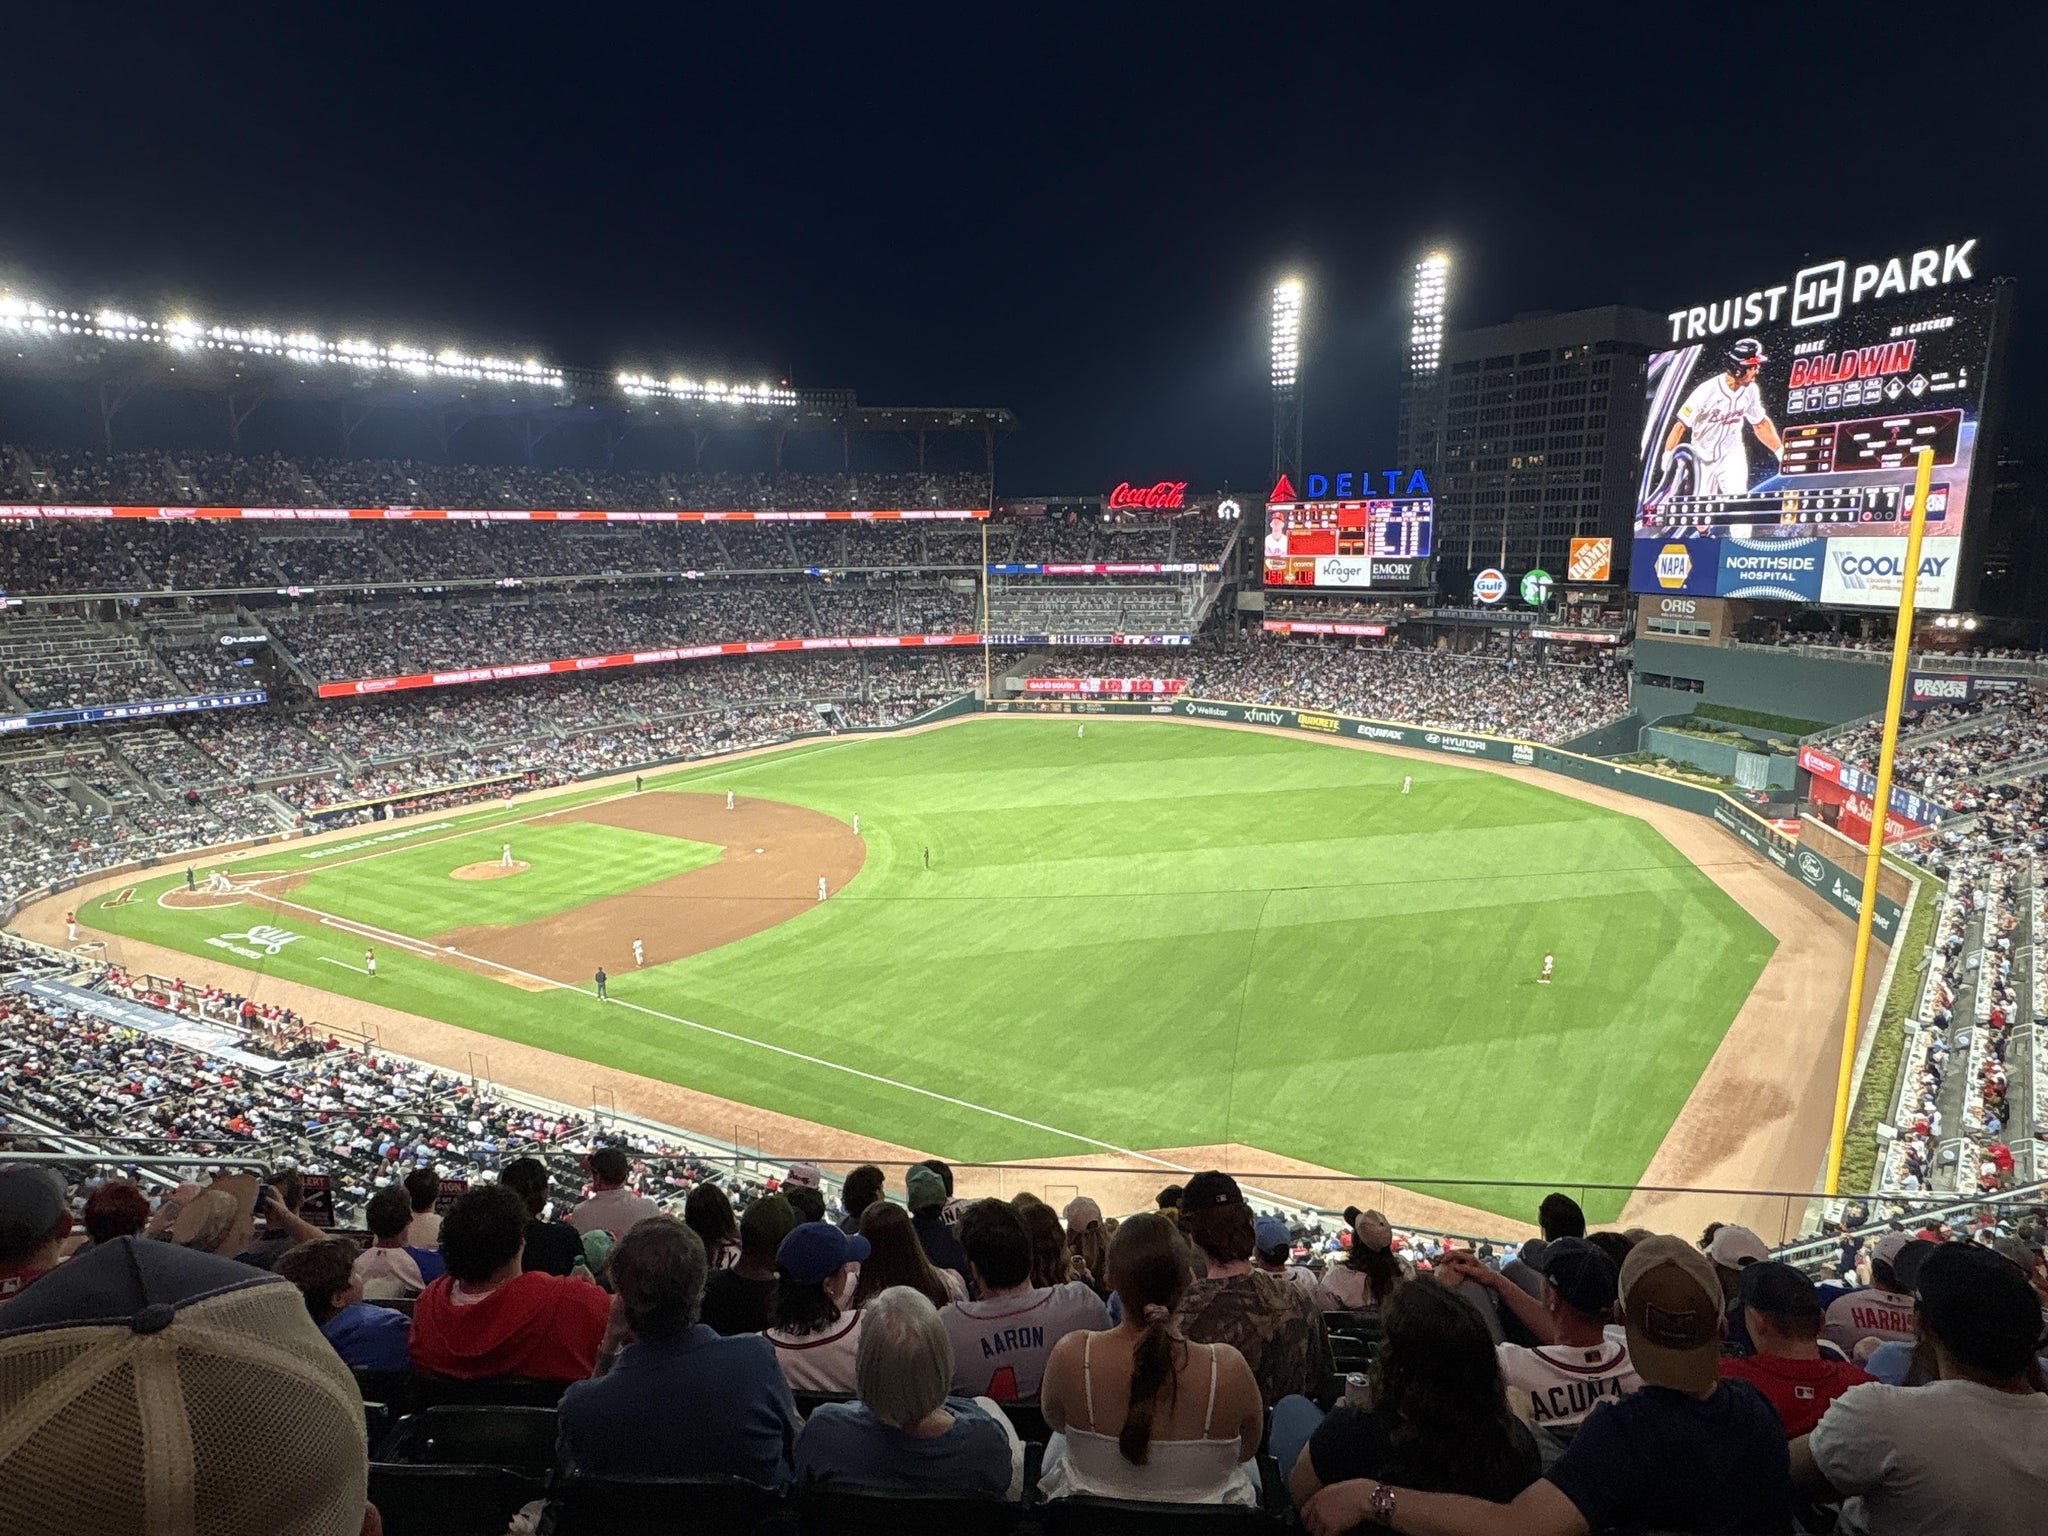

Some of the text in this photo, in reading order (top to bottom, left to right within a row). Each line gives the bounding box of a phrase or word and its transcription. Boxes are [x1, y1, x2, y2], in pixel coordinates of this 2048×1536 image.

[1668, 239, 1976, 342] TRUIST PARK
[1794, 340, 1826, 355] DRAKE
[1788, 339, 1917, 389] BALDWIN
[1308, 469, 1430, 498] DELTA
[1670, 505, 1677, 513] 0
[1681, 504, 1688, 513] 0
[1693, 504, 1700, 512] 2
[1705, 503, 1712, 512] 0
[1801, 499, 1809, 509] 7
[1816, 499, 1824, 508] 0
[1832, 498, 1840, 508] 7
[1849, 497, 1855, 507] 1
[1868, 493, 1876, 508] 1
[1886, 492, 1895, 508] 1
[1669, 516, 1676, 525] 0
[1680, 516, 1687, 525] 0
[1692, 516, 1698, 525] 2
[1704, 516, 1711, 525] 0
[1815, 512, 1823, 522] 0
[1830, 512, 1838, 522] 4
[1848, 512, 1854, 521] 1
[1570, 539, 1609, 579] HOME
[1660, 556, 1686, 577] NAPA
[1726, 556, 1815, 571] NORTHSIDE
[1841, 553, 1950, 577] COOLAY
[1323, 559, 1362, 583] Kroger
[1372, 563, 1413, 575] EMORY
[1740, 571, 1796, 582] HOSPITAL
[1477, 581, 1503, 591] Gulf
[1660, 599, 1696, 614] ORIS
[433, 664, 550, 684] SWING FOR THE FENCES
[1029, 681, 1044, 690] GAS
[1051, 682, 1075, 690] SOUTH
[1914, 678, 1968, 689] BRAVES
[1913, 687, 1967, 699] VISION
[1197, 706, 1228, 717] Wellstar
[1243, 708, 1284, 725] xfinity
[1297, 713, 1340, 730] QUIKRETE
[1357, 724, 1402, 741] EQUIFAX
[1442, 736, 1486, 750] HYUNDAI
[1857, 800, 1905, 838] Sta arm
[1802, 854, 1820, 878] Ford
[1842, 888, 1864, 914] Georg
[1872, 911, 1890, 930] ower
[302, 1177, 325, 1187] LERT
[980, 1326, 1043, 1359] AARON
